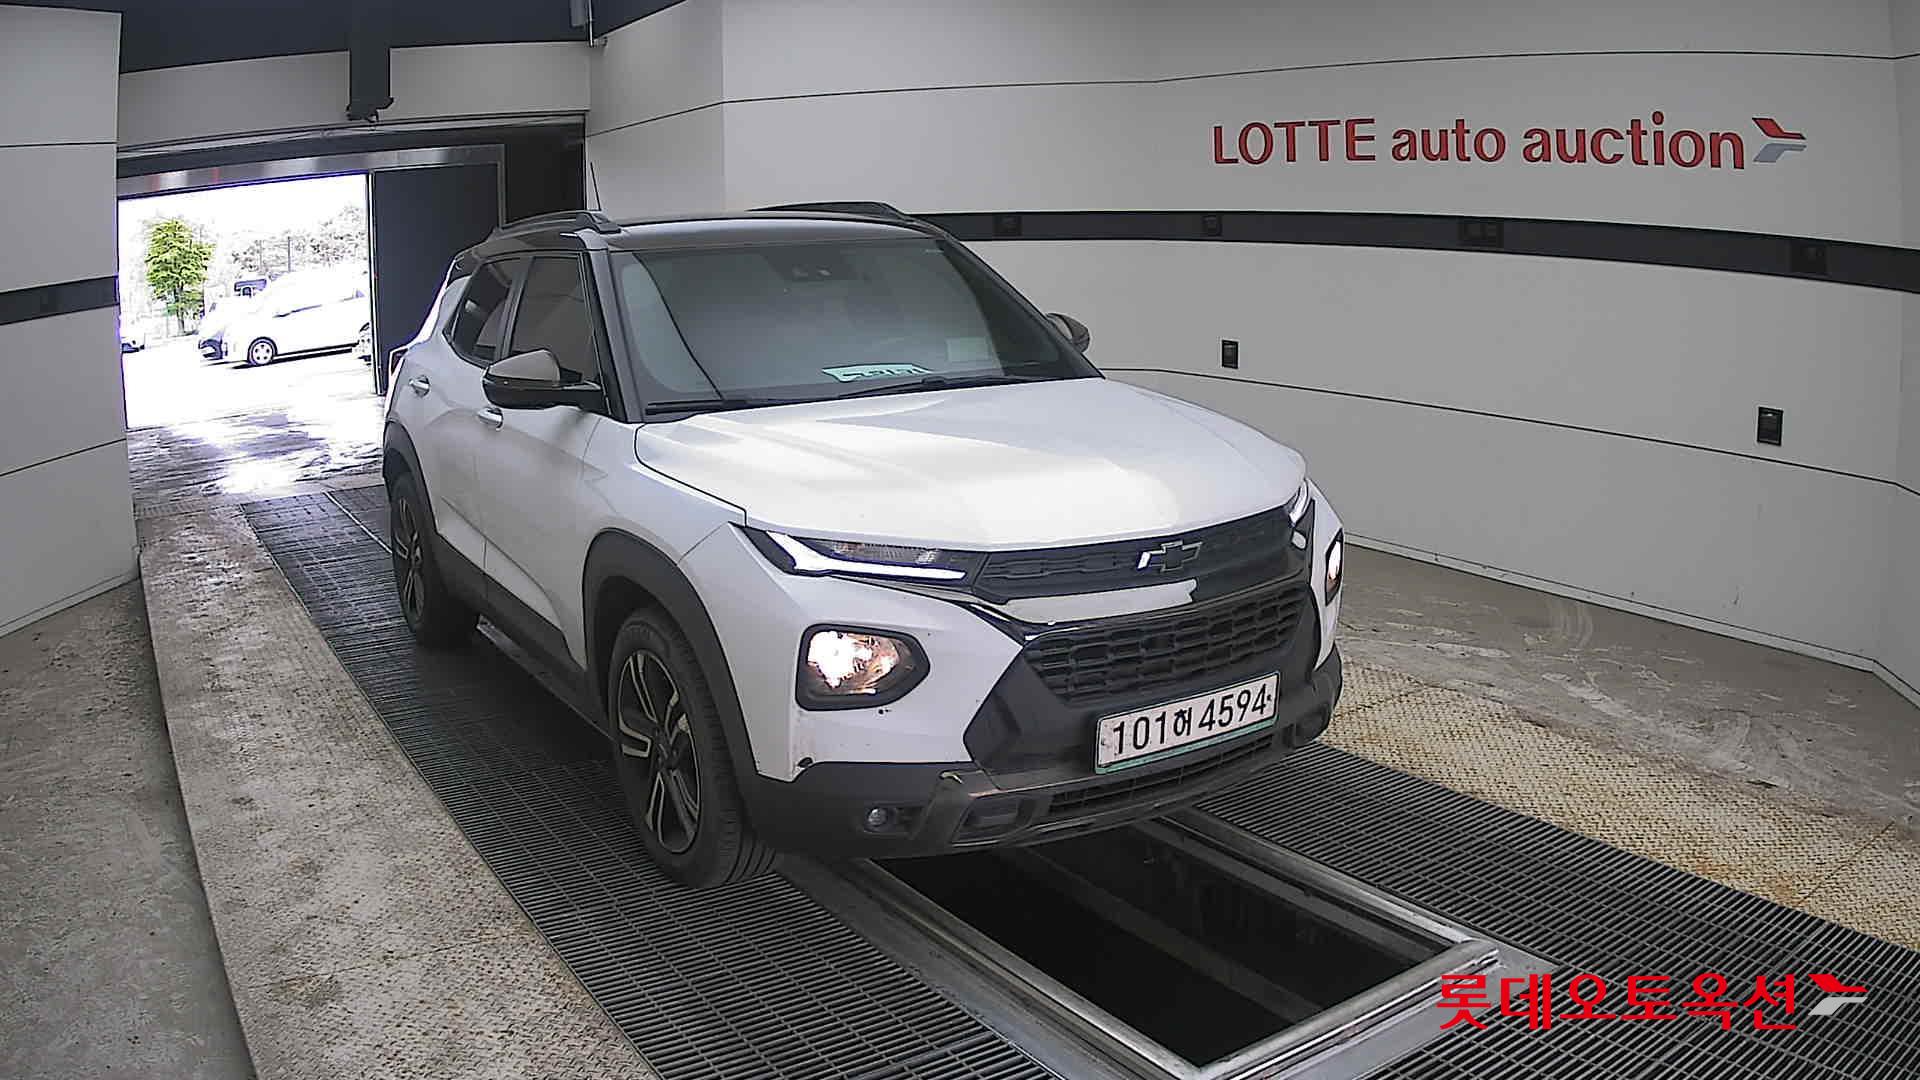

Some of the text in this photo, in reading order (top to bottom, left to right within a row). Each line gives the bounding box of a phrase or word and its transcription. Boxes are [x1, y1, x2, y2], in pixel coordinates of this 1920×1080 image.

[1212, 111, 1745, 170] LOTTE auto auction
